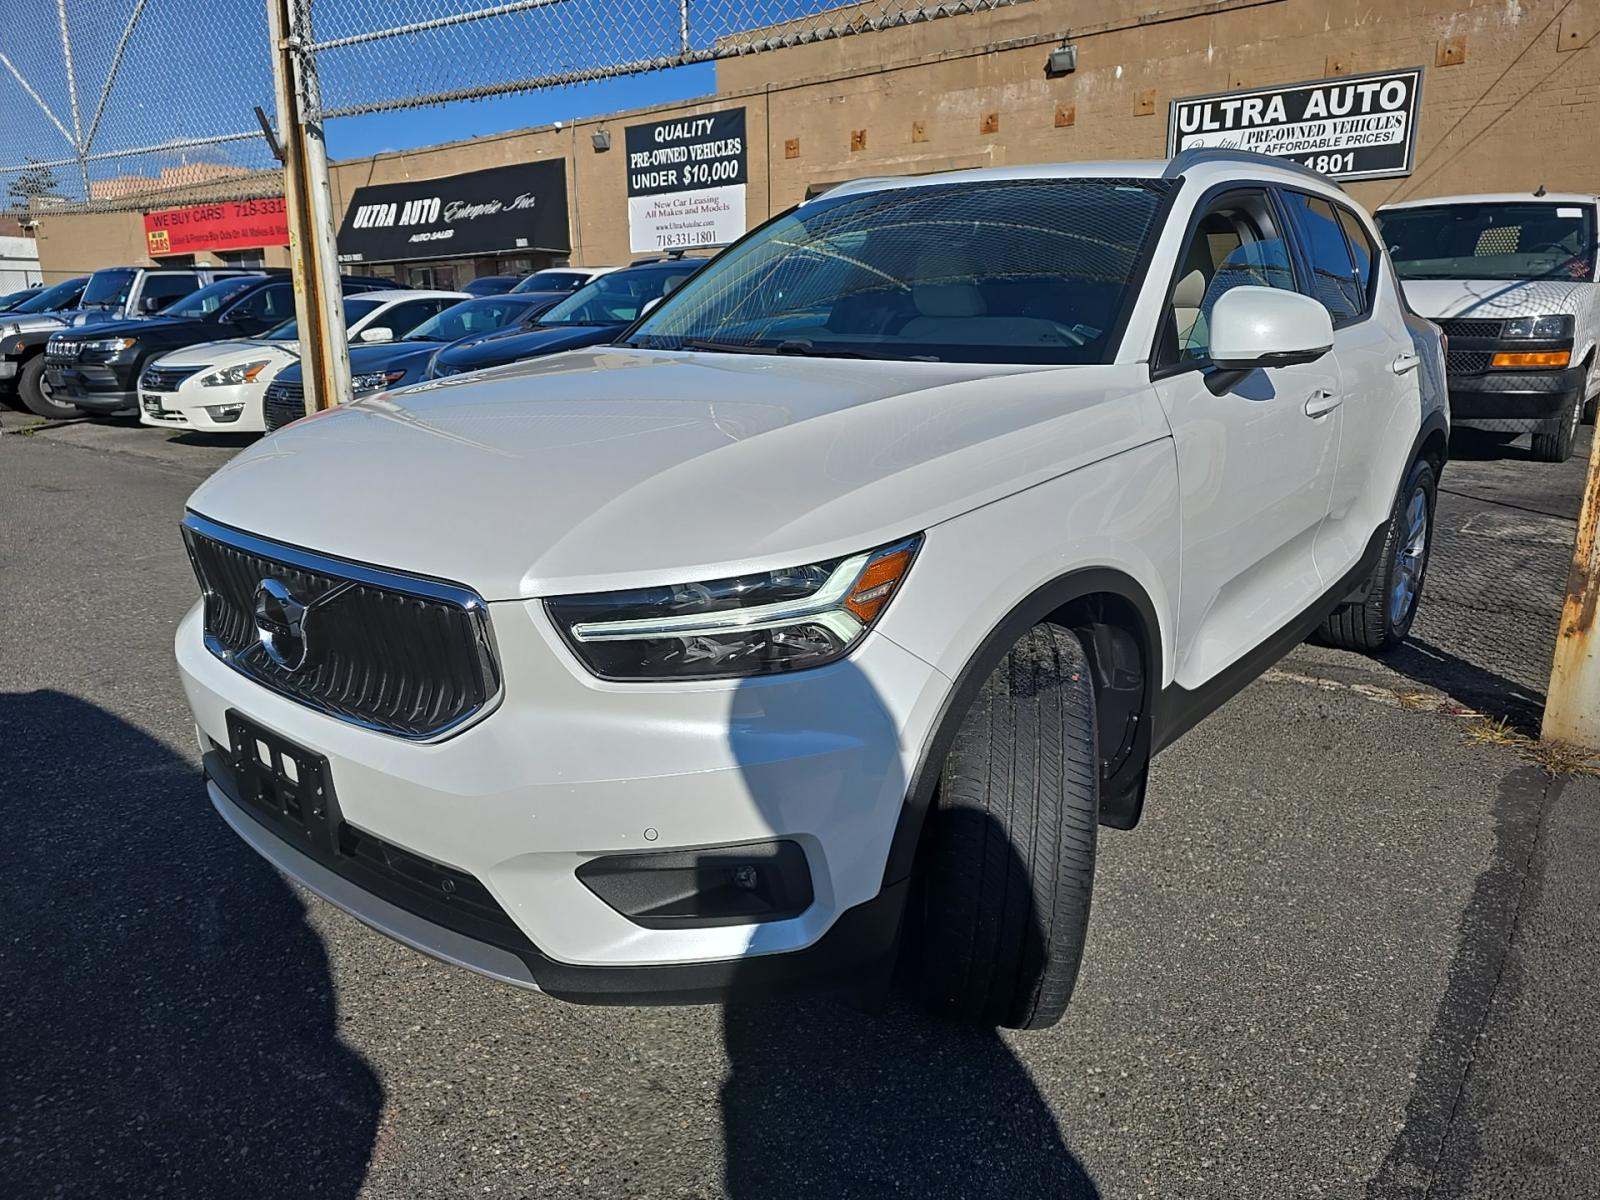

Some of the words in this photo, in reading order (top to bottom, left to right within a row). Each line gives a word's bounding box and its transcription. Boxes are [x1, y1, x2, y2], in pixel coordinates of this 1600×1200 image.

[1179, 95, 1287, 132] ULTRA
[1303, 80, 1407, 120] AUTO
[654, 118, 715, 143] QUALITY
[1247, 124, 1326, 145] PRE-OWNED
[1333, 114, 1403, 135] VEHICLES
[630, 146, 688, 169] PRE-OWNED
[688, 137, 742, 161] VEHICLES
[1264, 136, 1342, 155] AFFORDABLE
[1346, 131, 1395, 145] PRICES!
[632, 170, 678, 190] UNDER
[683, 159, 739, 186] $10,000
[353, 203, 397, 229] ULTRA
[399, 197, 441, 226] AUTO
[645, 210, 658, 219] All
[658, 207, 684, 218] Makes
[684, 205, 699, 215] and
[700, 202, 731, 213] Models
[654, 201, 672, 210] New
[673, 198, 687, 208] Car
[689, 195, 720, 206] Leasing
[153, 214, 169, 228] WE
[171, 211, 191, 225] BUY
[193, 207, 225, 223] CARS!
[408, 232, 431, 243] AUTO
[430, 229, 455, 240] SALES
[656, 230, 717, 247] 718-331-1801
